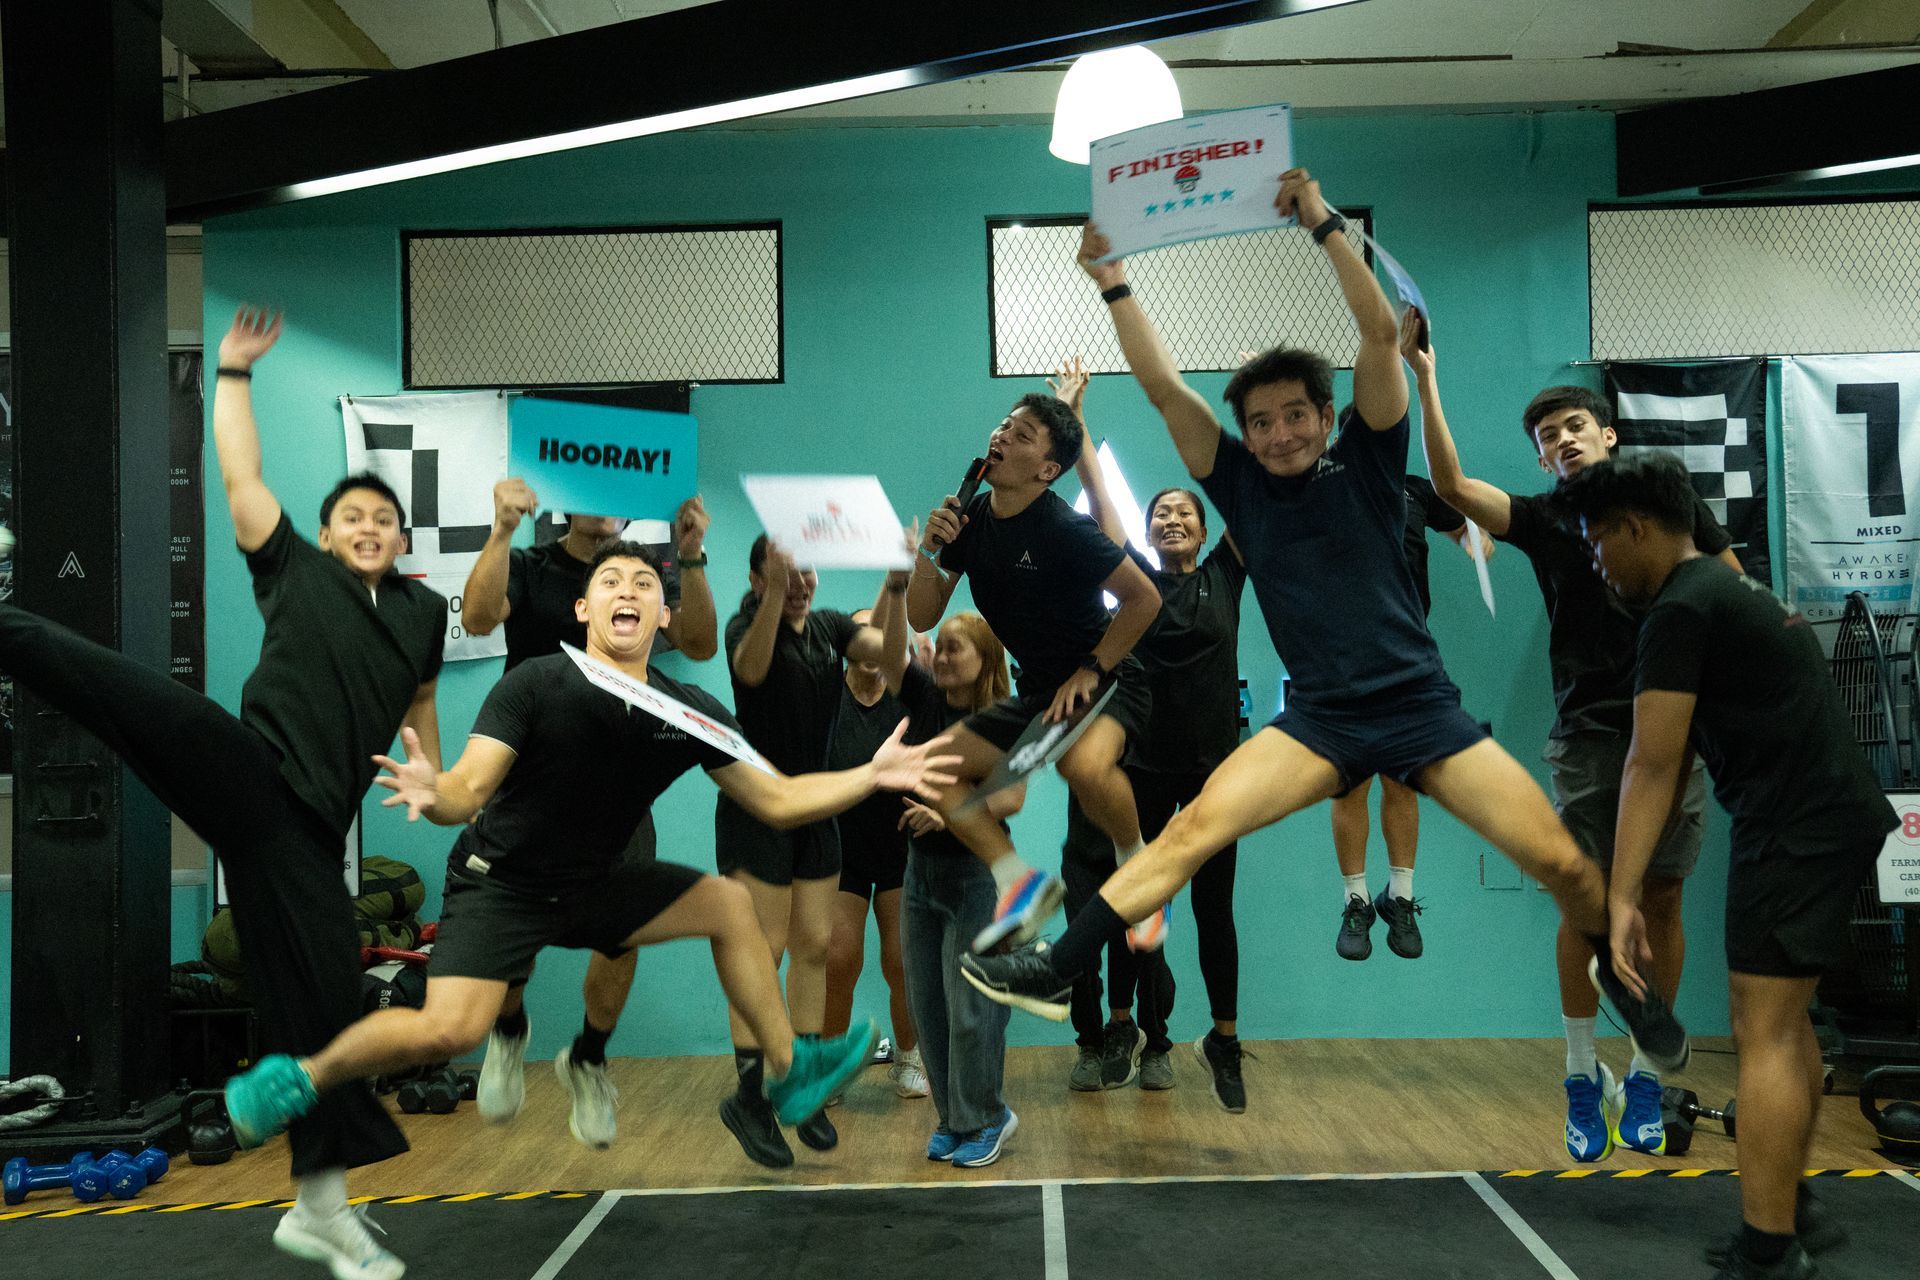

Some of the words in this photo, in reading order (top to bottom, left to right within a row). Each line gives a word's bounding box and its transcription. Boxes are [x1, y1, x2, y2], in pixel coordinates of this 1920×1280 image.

[1108, 139, 1264, 184] FINISHER!
[539, 437, 671, 475] HOORAY!
[1857, 525, 1902, 537] MIXED
[1839, 553, 1910, 565] AWAKE
[1832, 569, 1895, 580] HYROX
[1903, 812, 1920, 839] 8
[1891, 859, 1920, 867] FARM
[1900, 873, 1920, 881] CAR
[1904, 887, 1920, 897] (40
